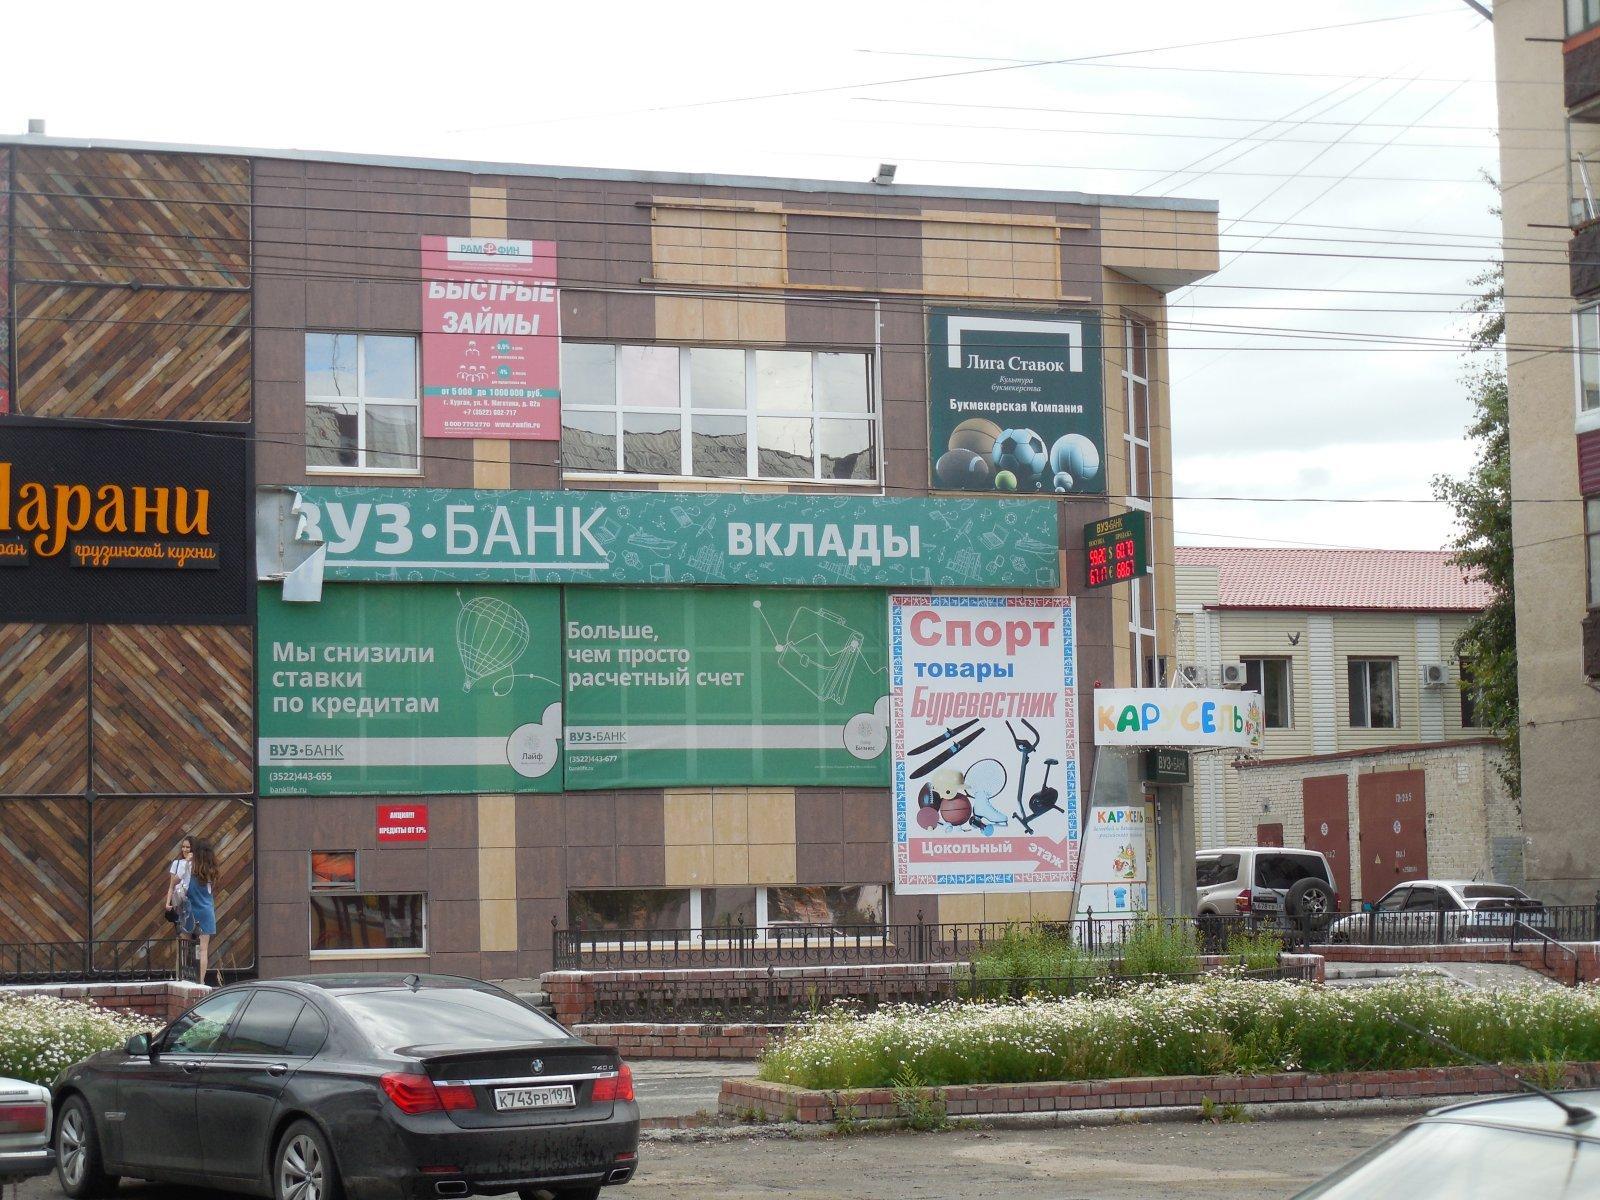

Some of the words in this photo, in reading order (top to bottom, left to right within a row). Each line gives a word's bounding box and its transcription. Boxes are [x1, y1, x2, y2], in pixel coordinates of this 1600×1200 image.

[428, 278, 555, 303] БЫСТРЫЕ
[441, 306, 540, 335] ЗАЙМЫ
[966, 354, 1005, 371] Лига
[1008, 356, 1065, 373] Ставок
[991, 383, 1042, 394] букмекерства
[999, 375, 1034, 386] Культура
[949, 398, 1028, 414] Букмекерская
[1030, 401, 1084, 414] Компания
[74, 543, 165, 567] грузинской
[168, 545, 216, 568] кухни
[728, 522, 921, 567] ВКЛАДЫ
[567, 621, 659, 642] Больше,
[909, 610, 1056, 656] Спорт
[272, 641, 316, 663] Мы
[323, 645, 435, 663] снизили
[568, 649, 611, 664] чем
[617, 648, 690, 668] просто
[272, 671, 363, 689] ставки
[568, 667, 690, 692] расчетный
[696, 670, 745, 687] счет
[913, 662, 1014, 683] товары
[272, 696, 304, 714] по
[311, 696, 440, 719] кредитам
[910, 685, 1058, 726] Буревестник
[1097, 701, 1244, 735] КАРУСЕЛЬ
[521, 752, 544, 762] Лайф
[921, 840, 1013, 857] Цокольный
[1027, 842, 1065, 869] этаж
